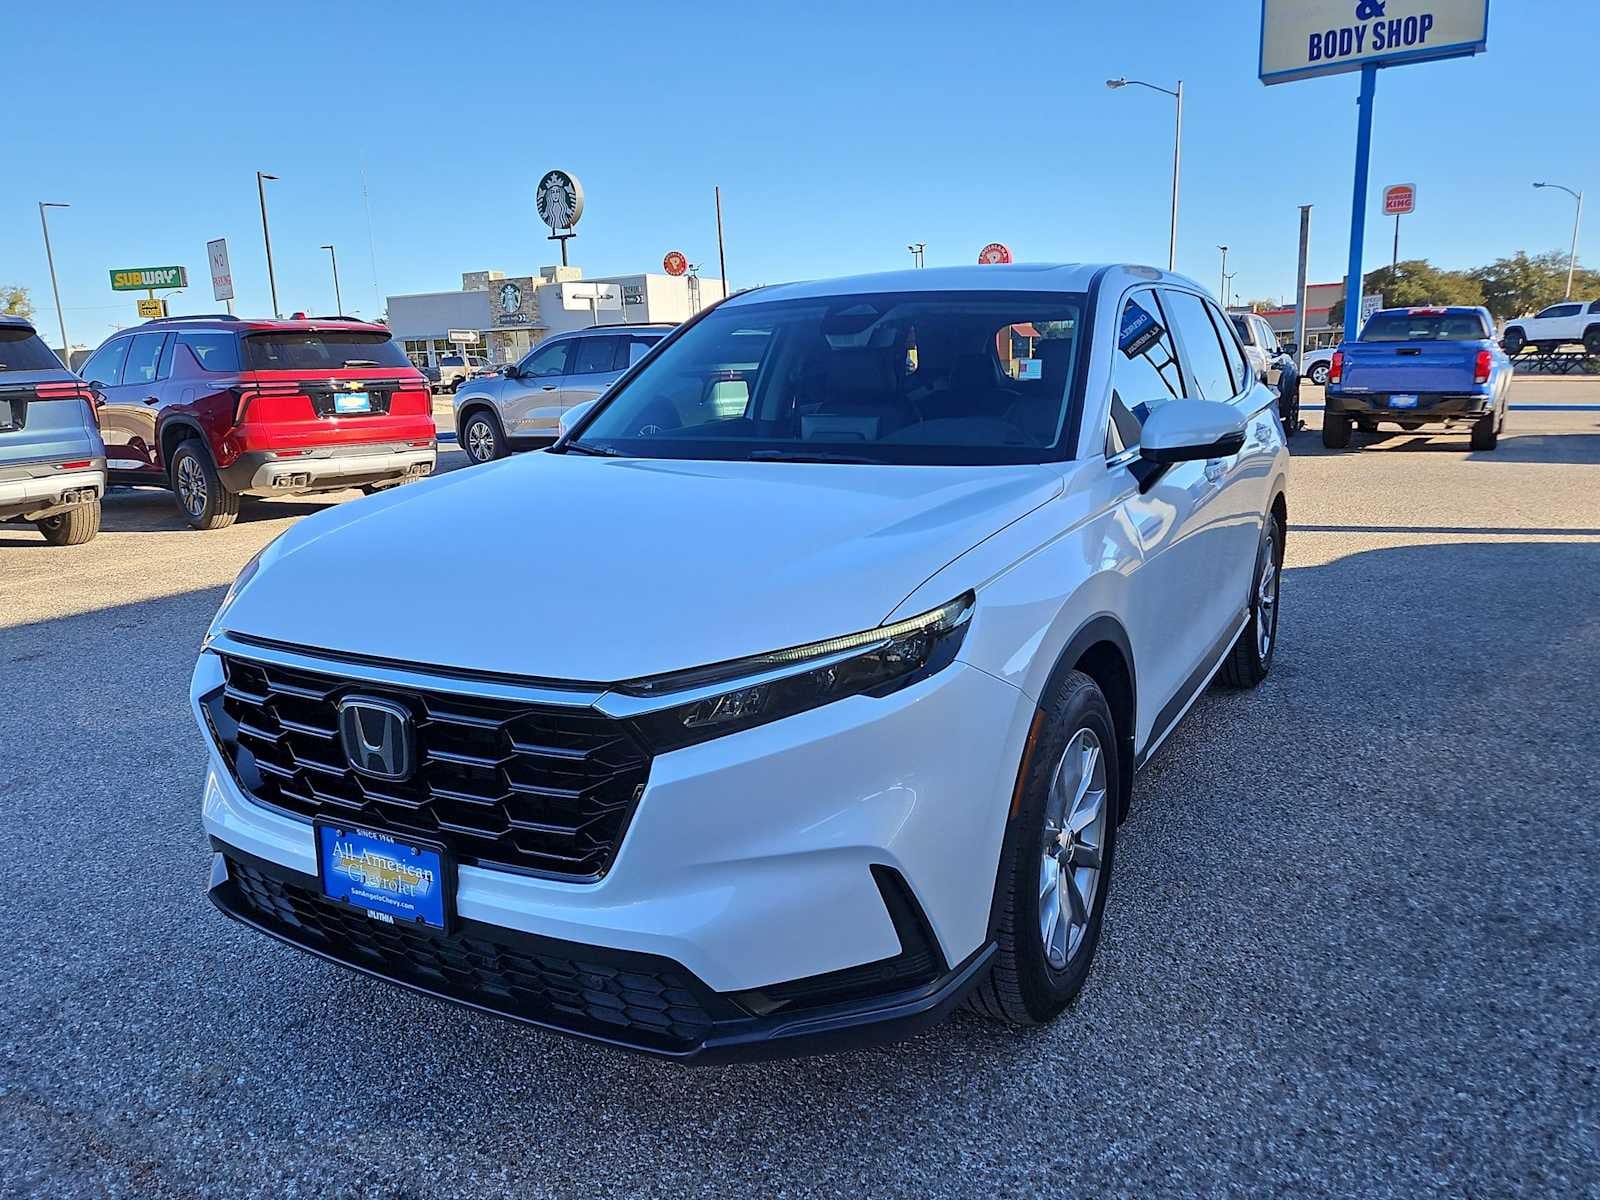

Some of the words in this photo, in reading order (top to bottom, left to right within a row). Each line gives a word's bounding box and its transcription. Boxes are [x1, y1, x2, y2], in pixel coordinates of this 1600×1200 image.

[1355, 0, 1386, 21] &
[1308, 24, 1367, 61] BODY
[1372, 14, 1433, 51] SHOP
[1385, 199, 1413, 209] KING
[213, 253, 225, 269] NO
[113, 269, 177, 288] SUBWAY
[356, 828, 378, 841] SINCE
[332, 841, 355, 861] All
[361, 848, 434, 882] American
